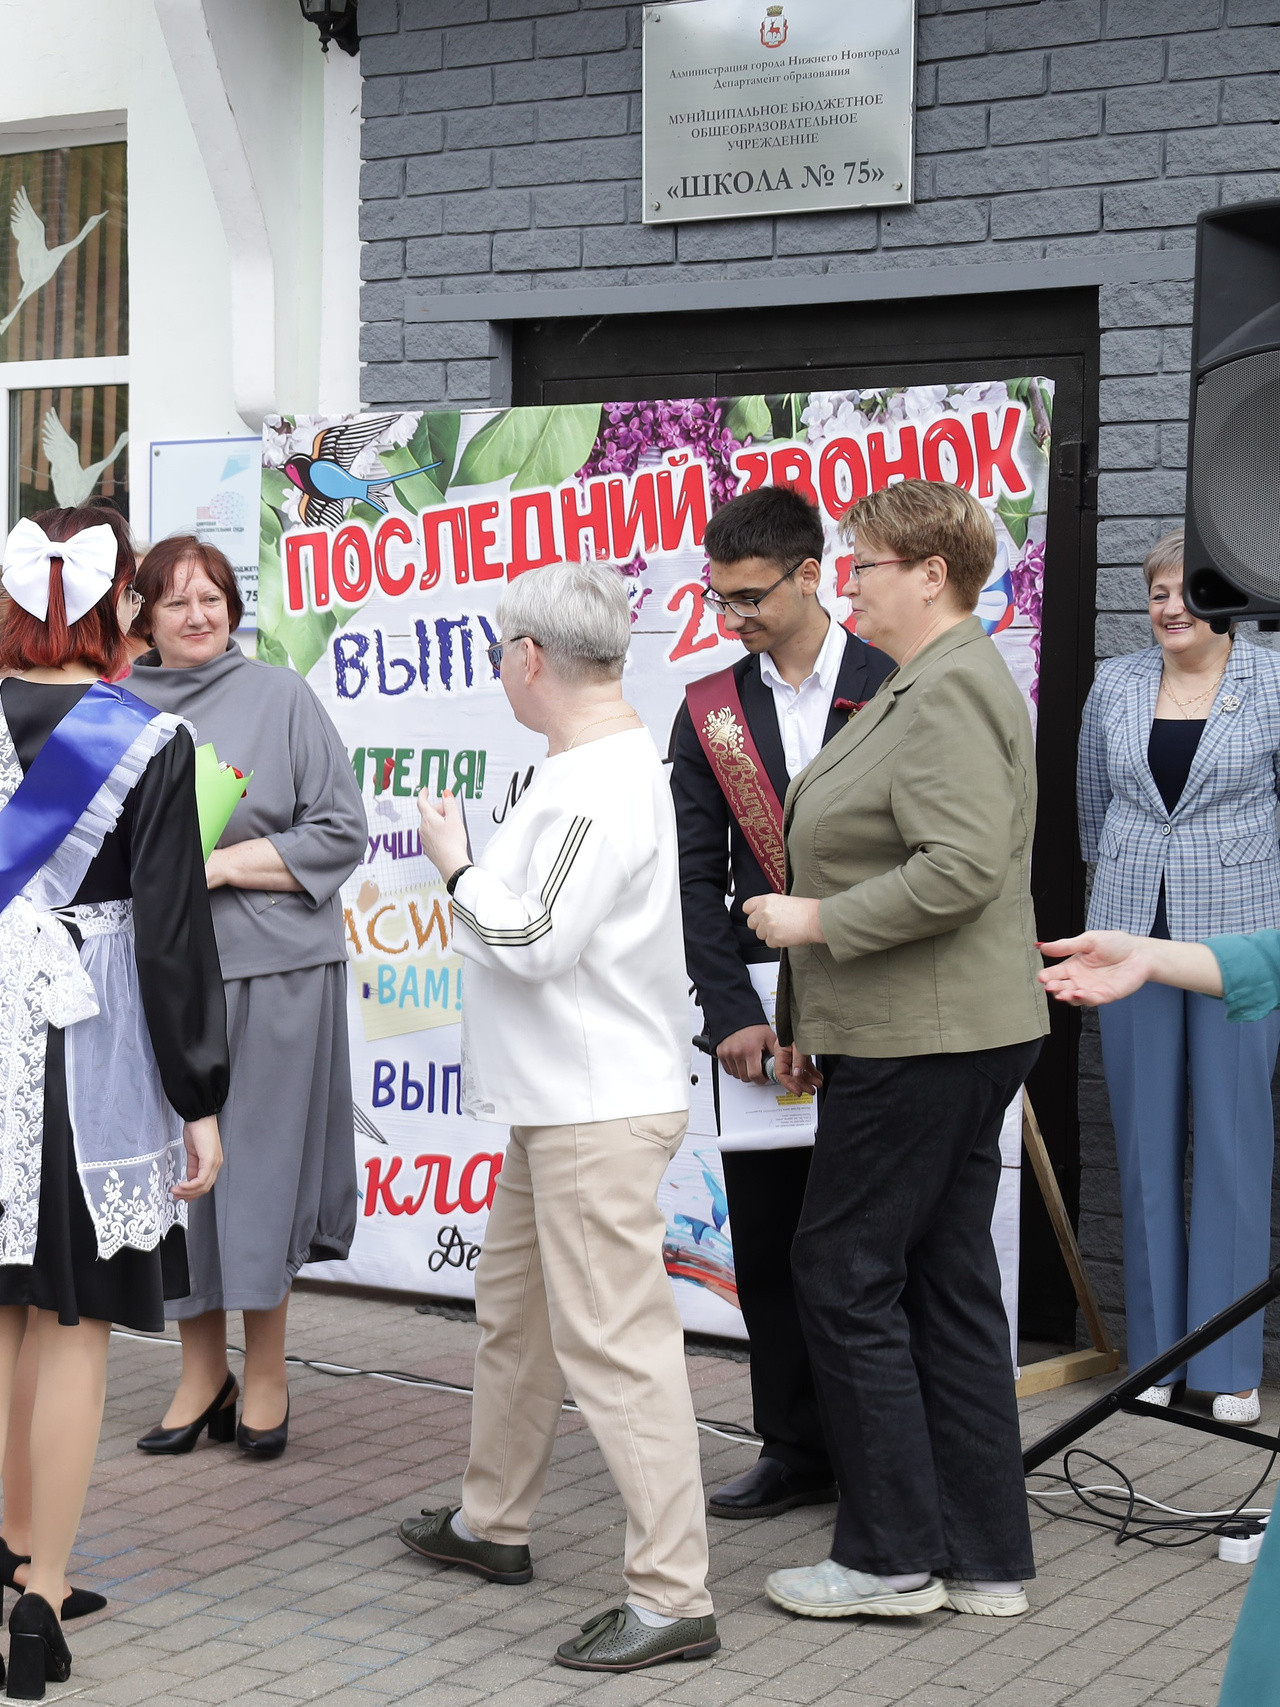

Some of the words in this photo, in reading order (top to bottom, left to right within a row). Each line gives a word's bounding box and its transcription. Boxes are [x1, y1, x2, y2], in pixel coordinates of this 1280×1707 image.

[669, 63, 748, 80] Администрация
[751, 59, 785, 74] города
[788, 52, 838, 67] Нижнего
[841, 47, 900, 64] Новгорода
[713, 73, 780, 90] Департамент
[783, 67, 850, 84] образования
[669, 103, 788, 125] МУНИЦИПАЛЬНОЕ
[791, 93, 884, 113] БЮДЖЕТНОЕ
[691, 112, 858, 139] ОБЩЕОБРАЗОВАТЕЛЬНОЕ
[727, 132, 819, 151] УЧРЕЖДЕНИЕ
[667, 167, 793, 199] «ШКОЛА
[801, 163, 835, 188] №
[843, 160, 885, 184] 75»
[285, 453, 709, 611] ПОСЛЕДНИЙ
[360, 828, 424, 866] УЧШ
[344, 899, 454, 955] АСИ
[378, 964, 462, 1011] ВАМ!
